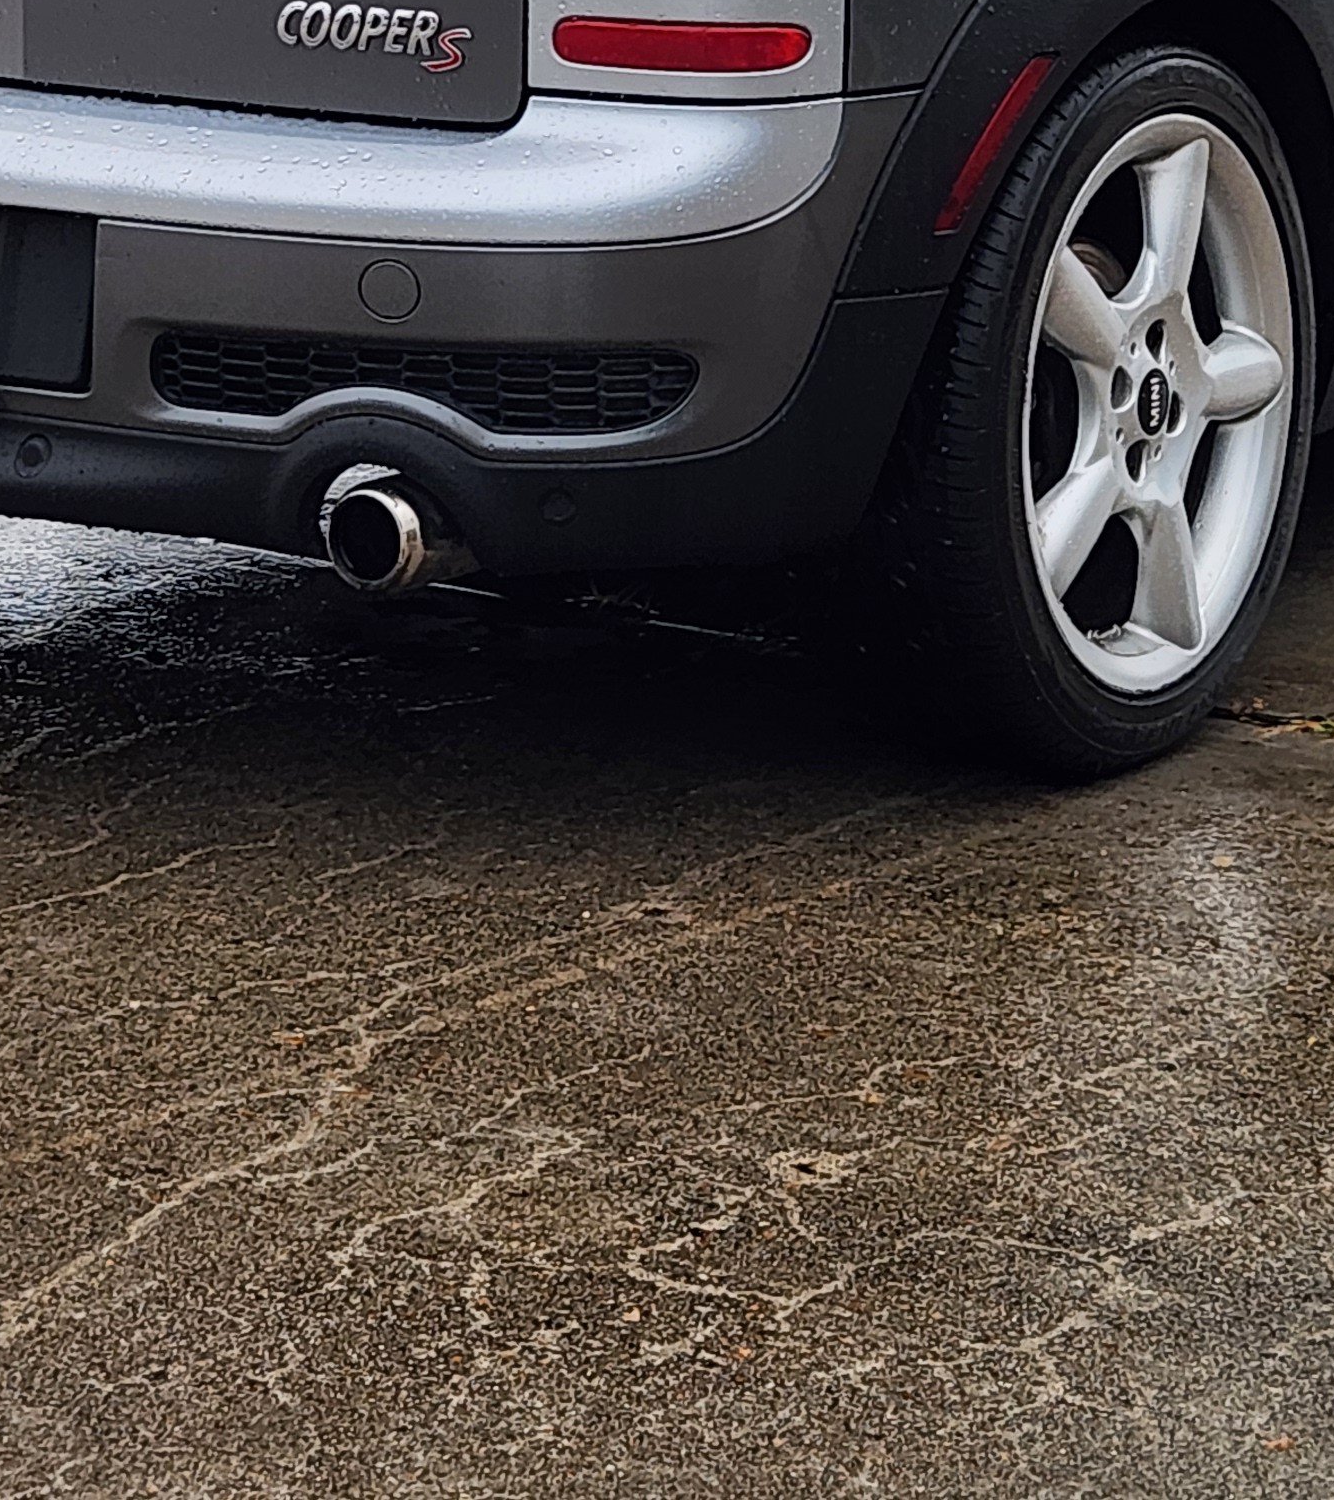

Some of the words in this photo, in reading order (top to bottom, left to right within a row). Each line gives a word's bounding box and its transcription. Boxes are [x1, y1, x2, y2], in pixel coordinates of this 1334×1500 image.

[277, 0, 440, 56] COOPER
[419, 28, 472, 73] S
[1149, 377, 1162, 428] MINI
